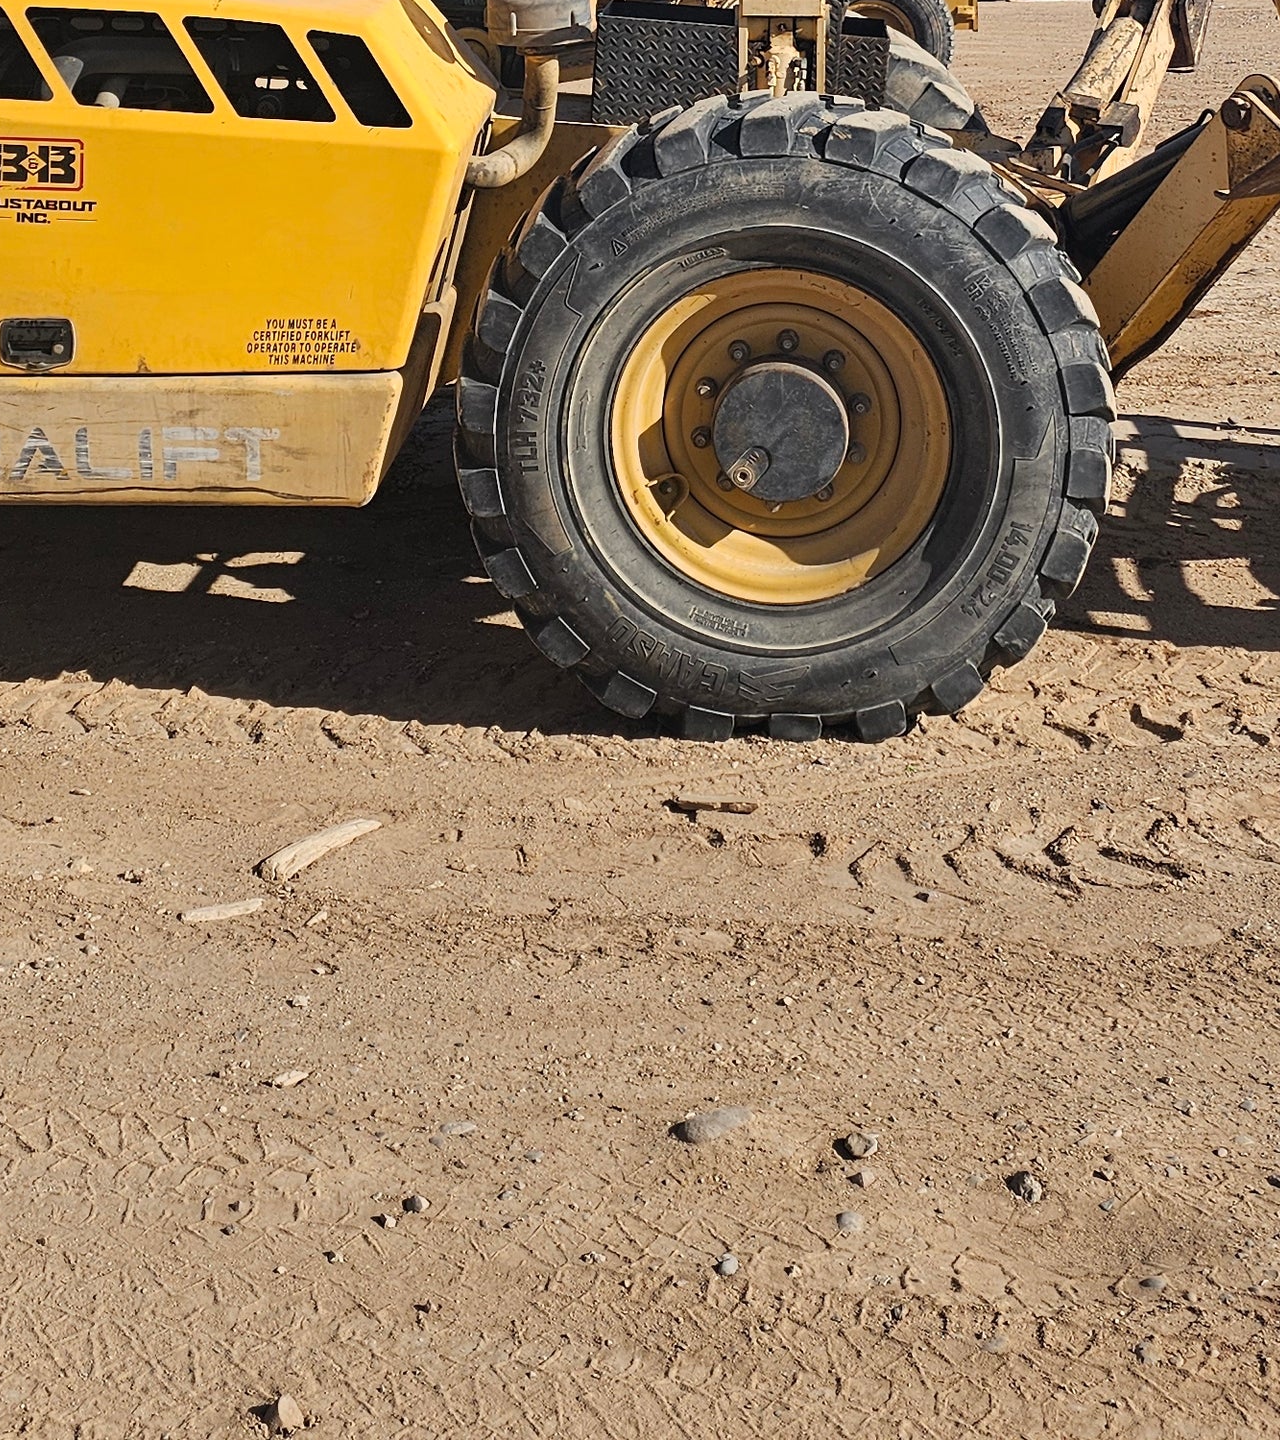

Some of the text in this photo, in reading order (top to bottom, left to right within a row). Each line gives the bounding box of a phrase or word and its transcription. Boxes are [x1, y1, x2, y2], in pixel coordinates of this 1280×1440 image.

[16, 212, 51, 224] INC.
[266, 319, 337, 329] YOU MUST BE A
[253, 330, 350, 341] CERTIFIED FORKLIFT
[246, 342, 356, 353] OPERATOR TO OPERATE
[268, 354, 335, 365] THIS MACHINE
[960, 520, 1035, 619] 14.00-24
[606, 614, 730, 694] CAMSO
